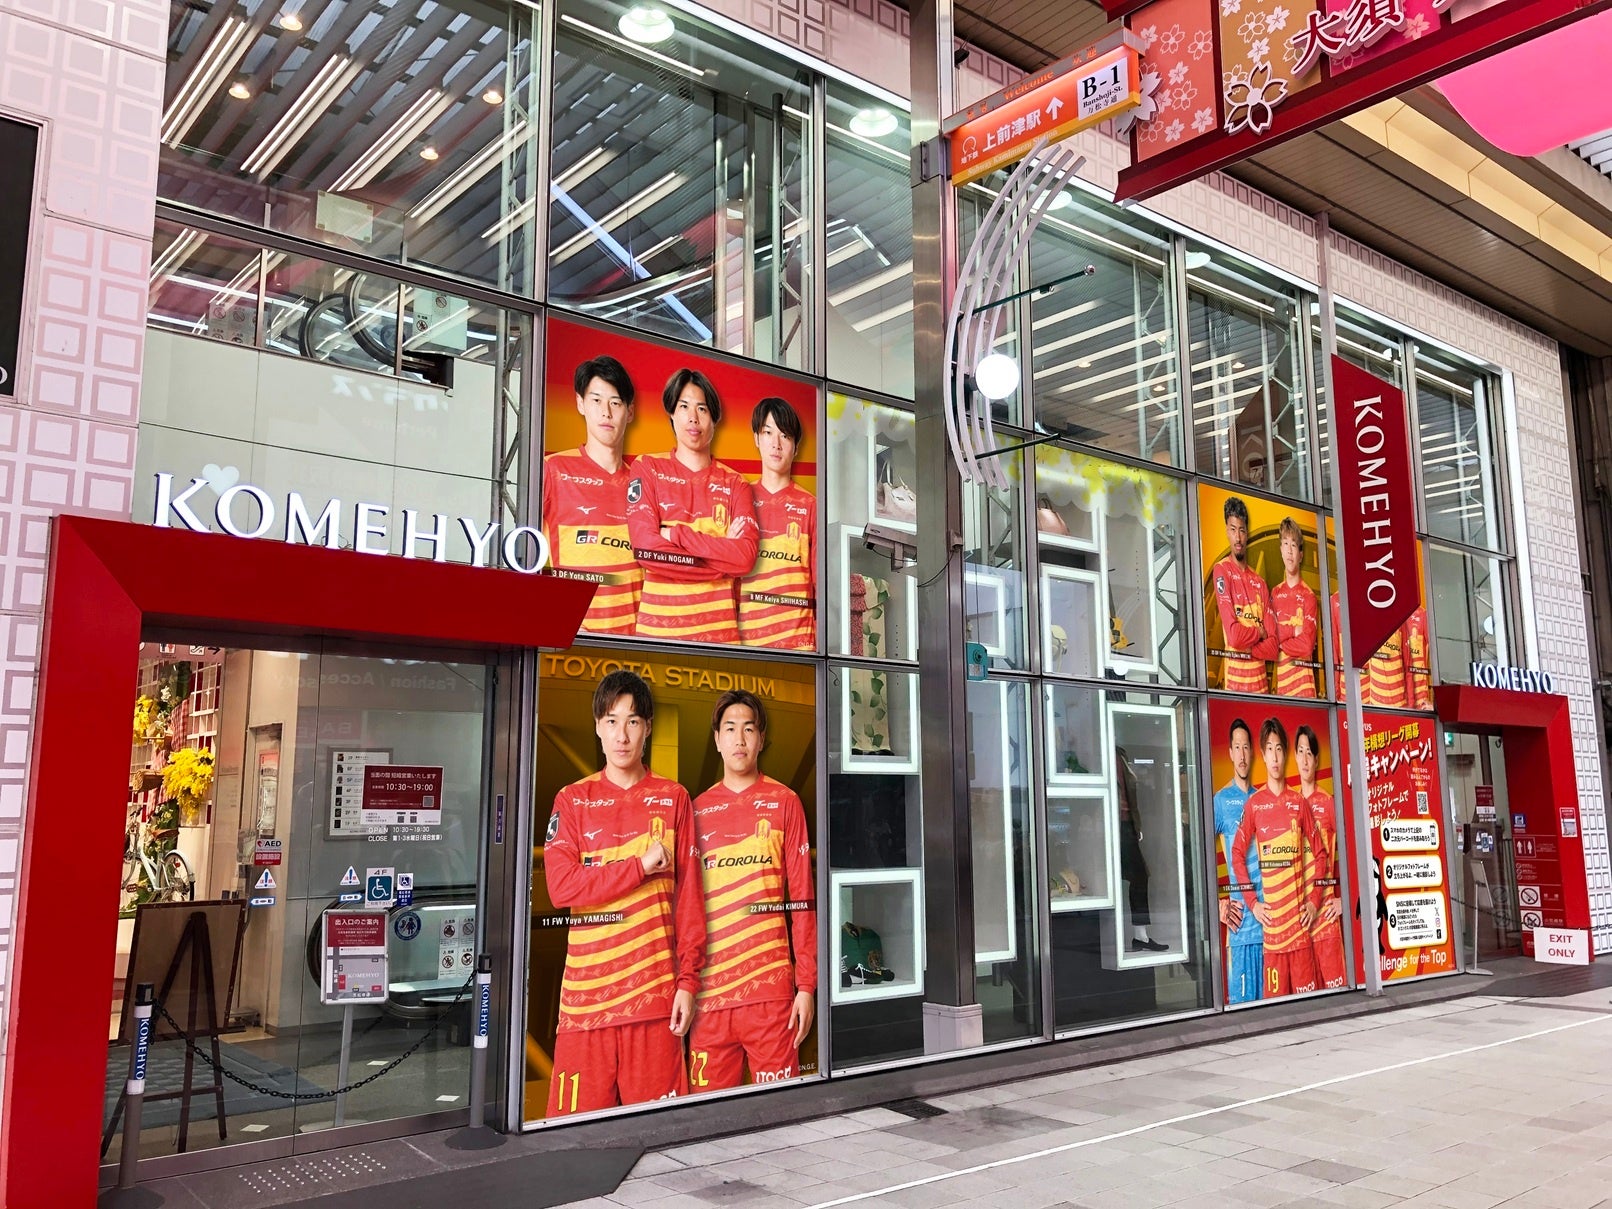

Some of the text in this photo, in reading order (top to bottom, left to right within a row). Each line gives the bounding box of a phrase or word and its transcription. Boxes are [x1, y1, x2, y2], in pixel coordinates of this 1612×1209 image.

[1003, 71, 1054, 101] Welcome
[1081, 64, 1121, 100] B-1
[982, 108, 1042, 153] 上前津駅
[1354, 395, 1396, 609] KOMEHYO
[153, 471, 550, 575] KOMEHYO
[668, 555, 694, 564] NOGAMI
[586, 574, 604, 583] SATO
[665, 666, 776, 698] STADIUM
[1471, 661, 1554, 695] KOMEHYO
[264, 840, 282, 848] AED
[717, 854, 773, 868] COROLLA
[542, 918, 550, 926] 11
[552, 918, 563, 926] FW
[583, 914, 624, 924] YAMAGISHI
[758, 904, 768, 912] FW
[786, 902, 808, 910] KIMURA
[335, 918, 379, 926] 出入口のご案内
[1549, 934, 1573, 944] EXIT
[1410, 954, 1420, 964] for
[1420, 953, 1431, 964] the
[1431, 949, 1447, 966] Top
[1548, 948, 1576, 958] ONLY
[1240, 974, 1246, 997] 1
[1266, 967, 1280, 994] 19
[480, 984, 490, 1037] KOMEHYO
[135, 1018, 150, 1080] KOMEHYO
[690, 1050, 710, 1087] 22
[558, 1072, 580, 1113] 11
